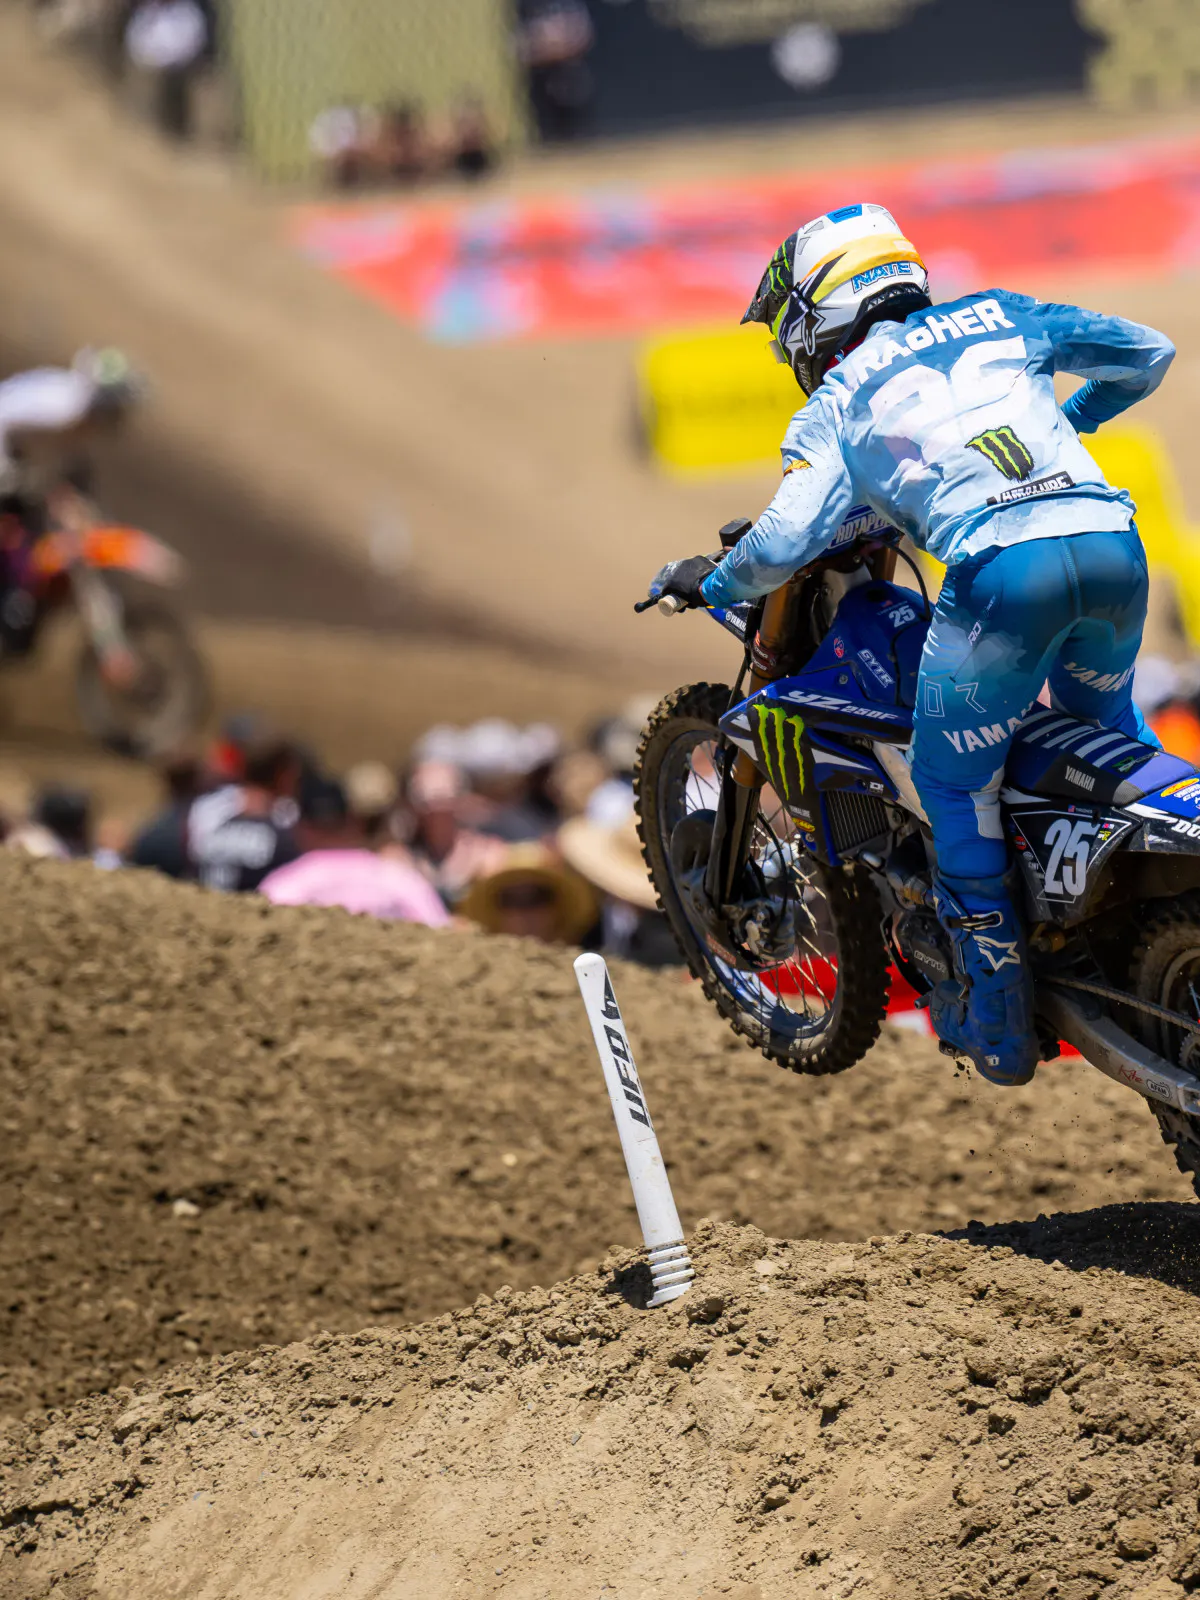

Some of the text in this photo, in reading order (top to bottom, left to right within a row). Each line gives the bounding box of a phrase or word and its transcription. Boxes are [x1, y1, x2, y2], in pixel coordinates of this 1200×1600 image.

[851, 261, 912, 293] NATE
[730, 613, 747, 632] YAMAH
[889, 605, 916, 628] 25
[858, 649, 895, 688] GYTR
[942, 701, 1034, 754] YAMA
[1065, 765, 1096, 792] YAMAHA
[1044, 818, 1100, 896] 25
